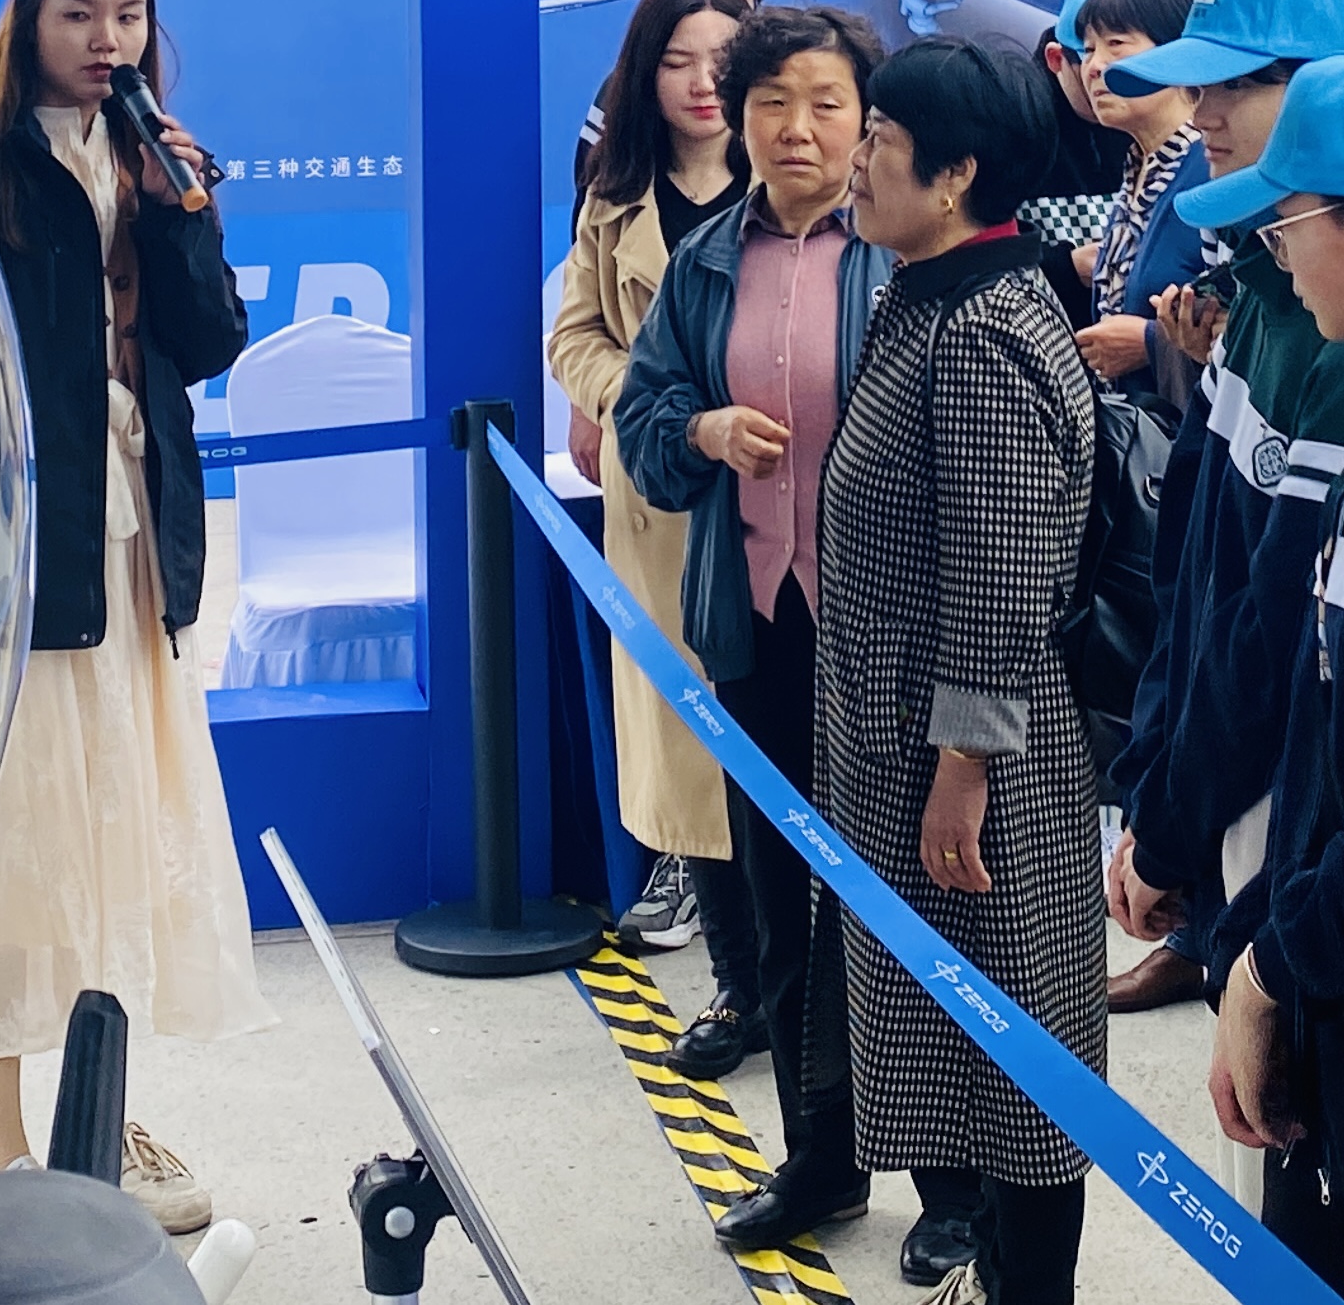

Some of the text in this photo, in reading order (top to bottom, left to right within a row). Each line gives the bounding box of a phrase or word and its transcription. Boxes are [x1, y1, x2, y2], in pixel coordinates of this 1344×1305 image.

[226, 155, 404, 181] 第三种交通生态
[954, 983, 1010, 1034] ZEROG
[1169, 1181, 1243, 1259] ZEROG
